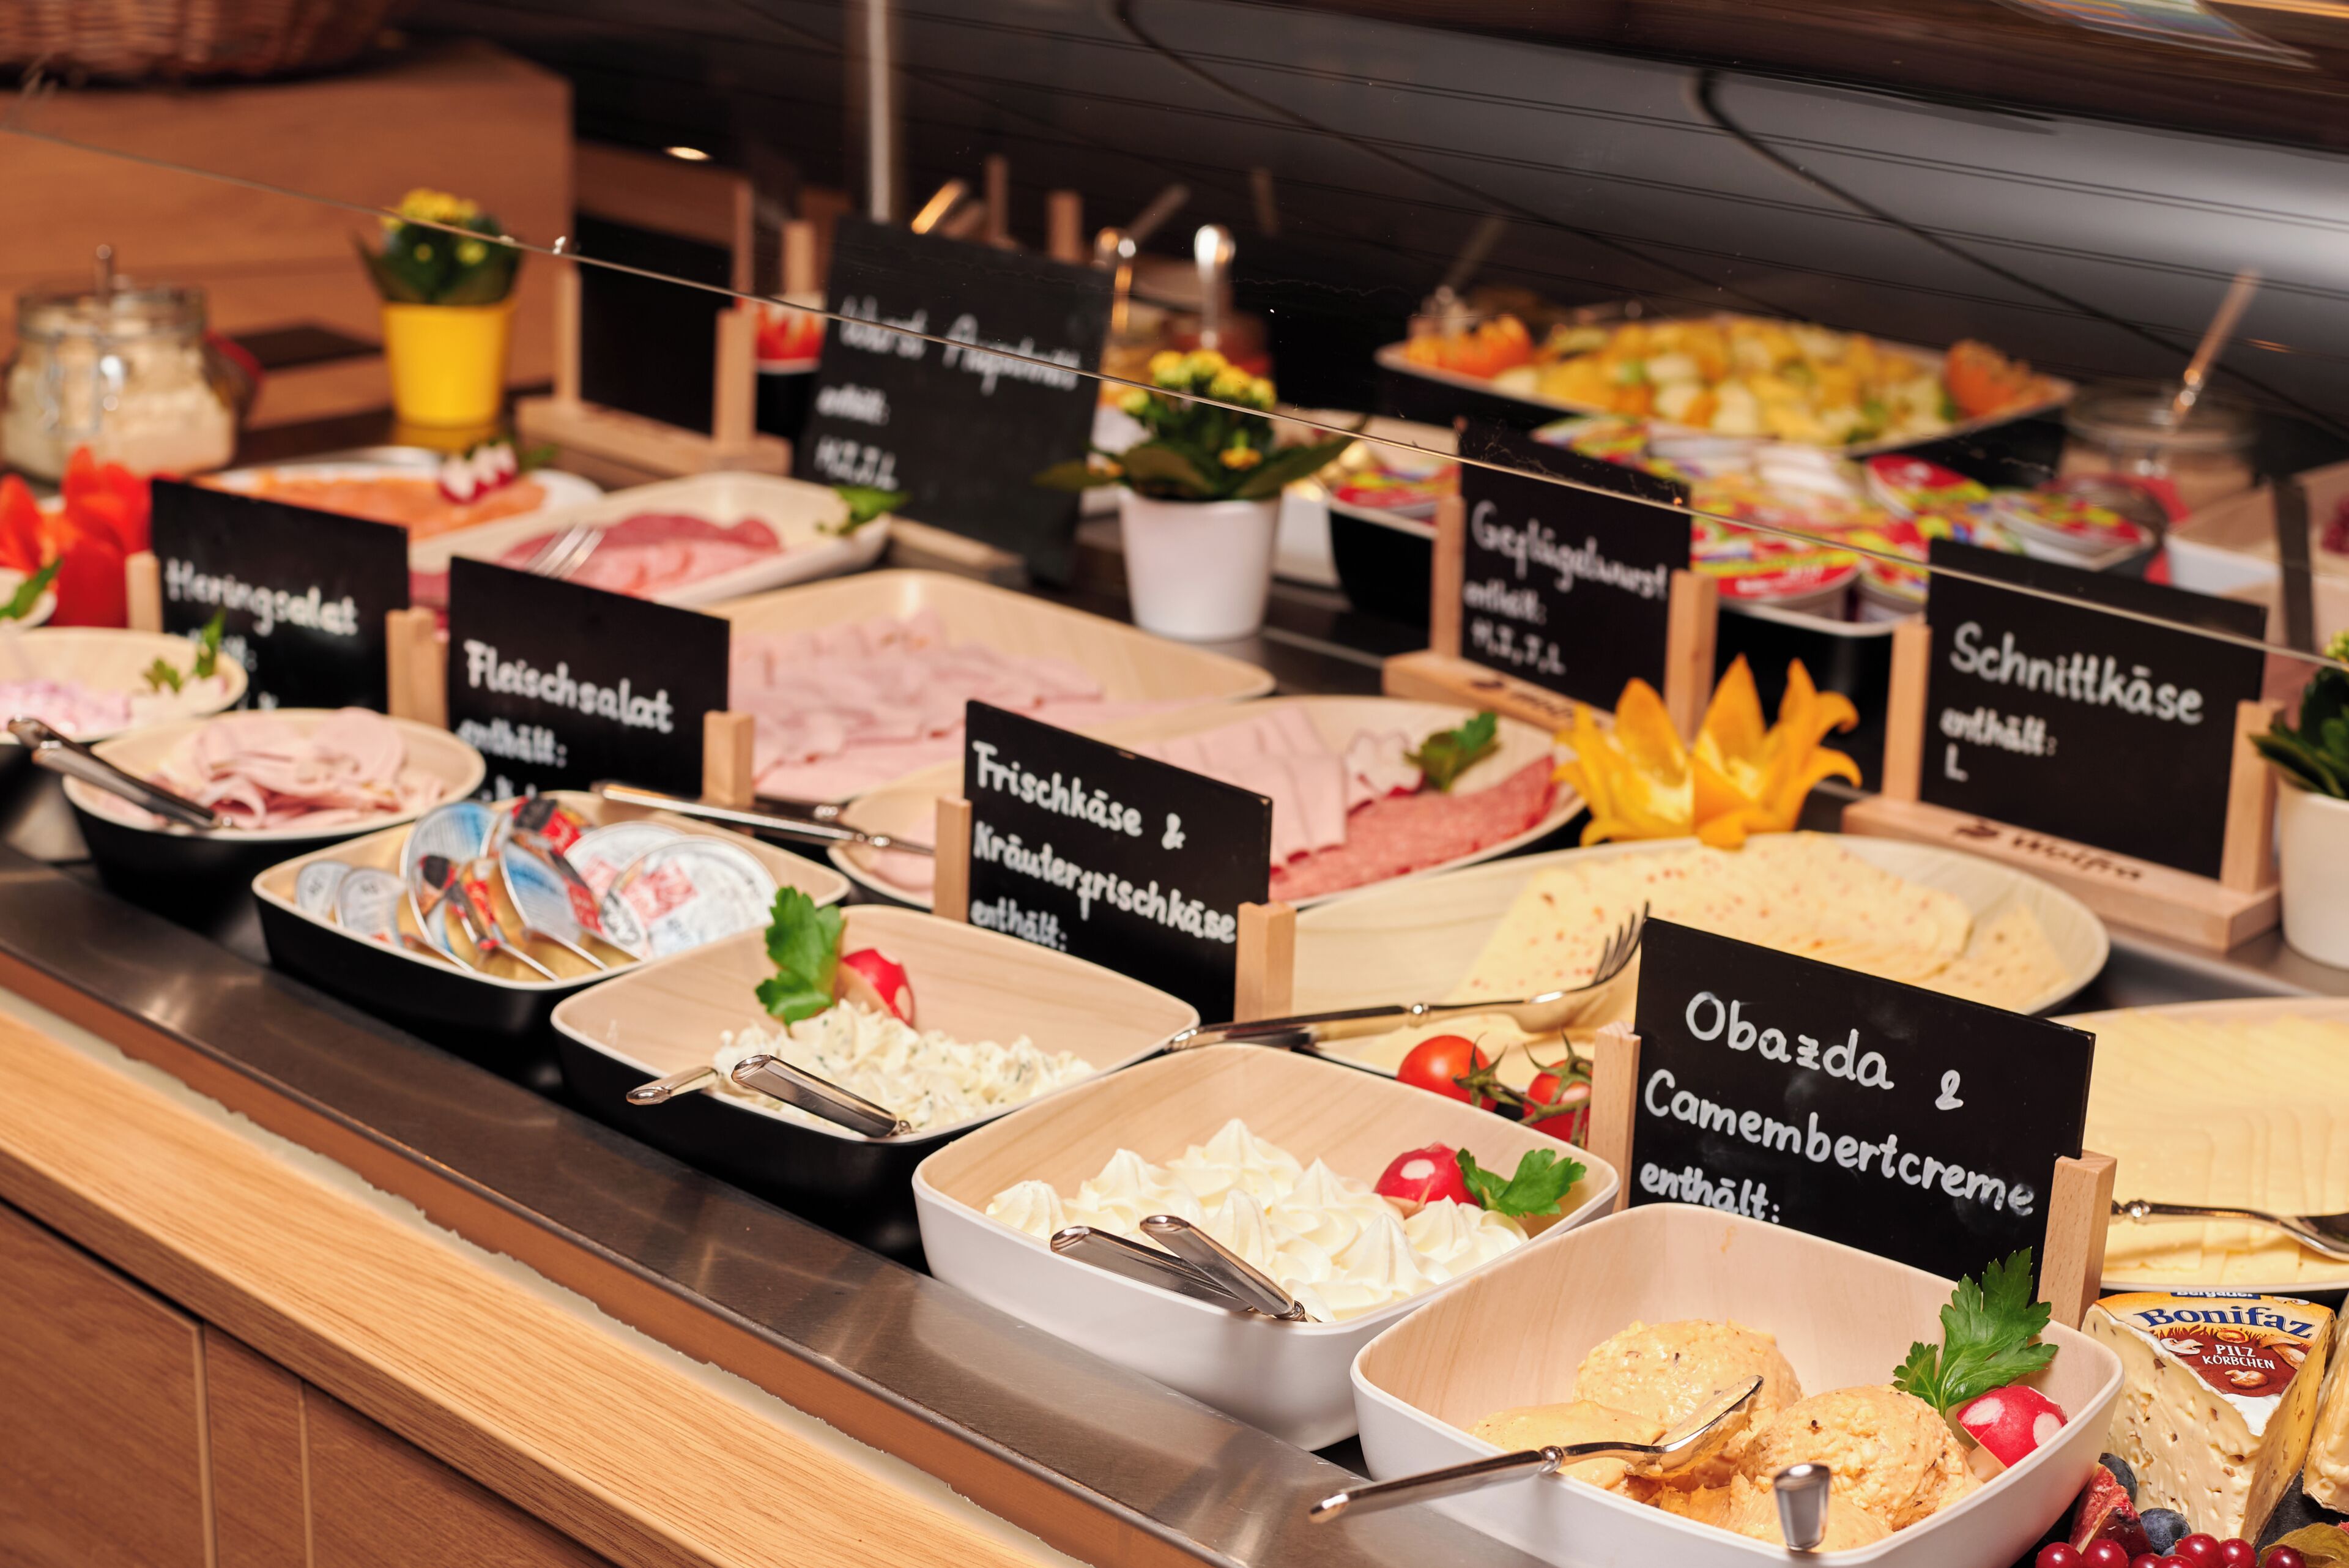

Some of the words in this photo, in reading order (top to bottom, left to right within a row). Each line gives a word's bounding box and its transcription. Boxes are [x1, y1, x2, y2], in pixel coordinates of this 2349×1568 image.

[1472, 500, 1668, 599] Geflügelwurst
[165, 557, 359, 637] Heringsalat
[464, 639, 674, 734] Fleischsalat
[1950, 621, 2203, 726] Schnittkäse
[1940, 707, 2057, 756] enthält:
[1944, 744, 1968, 782] L
[973, 740, 1143, 837] Frischkäse
[1162, 812, 1186, 850] &
[973, 821, 1236, 943] Kräuterfrischkäse
[970, 896, 1067, 953] enthält:
[1685, 991, 1894, 1090] Obazda
[1935, 1069, 1964, 1110] &
[1644, 1069, 2035, 1217] Camembertcreme
[1640, 1162, 1779, 1224] enthält:
[2133, 1306, 2315, 1339] Bonifaz
[2202, 1354, 2276, 1370] KÖRBCHEN
[2214, 1344, 2256, 1357] PILZ
